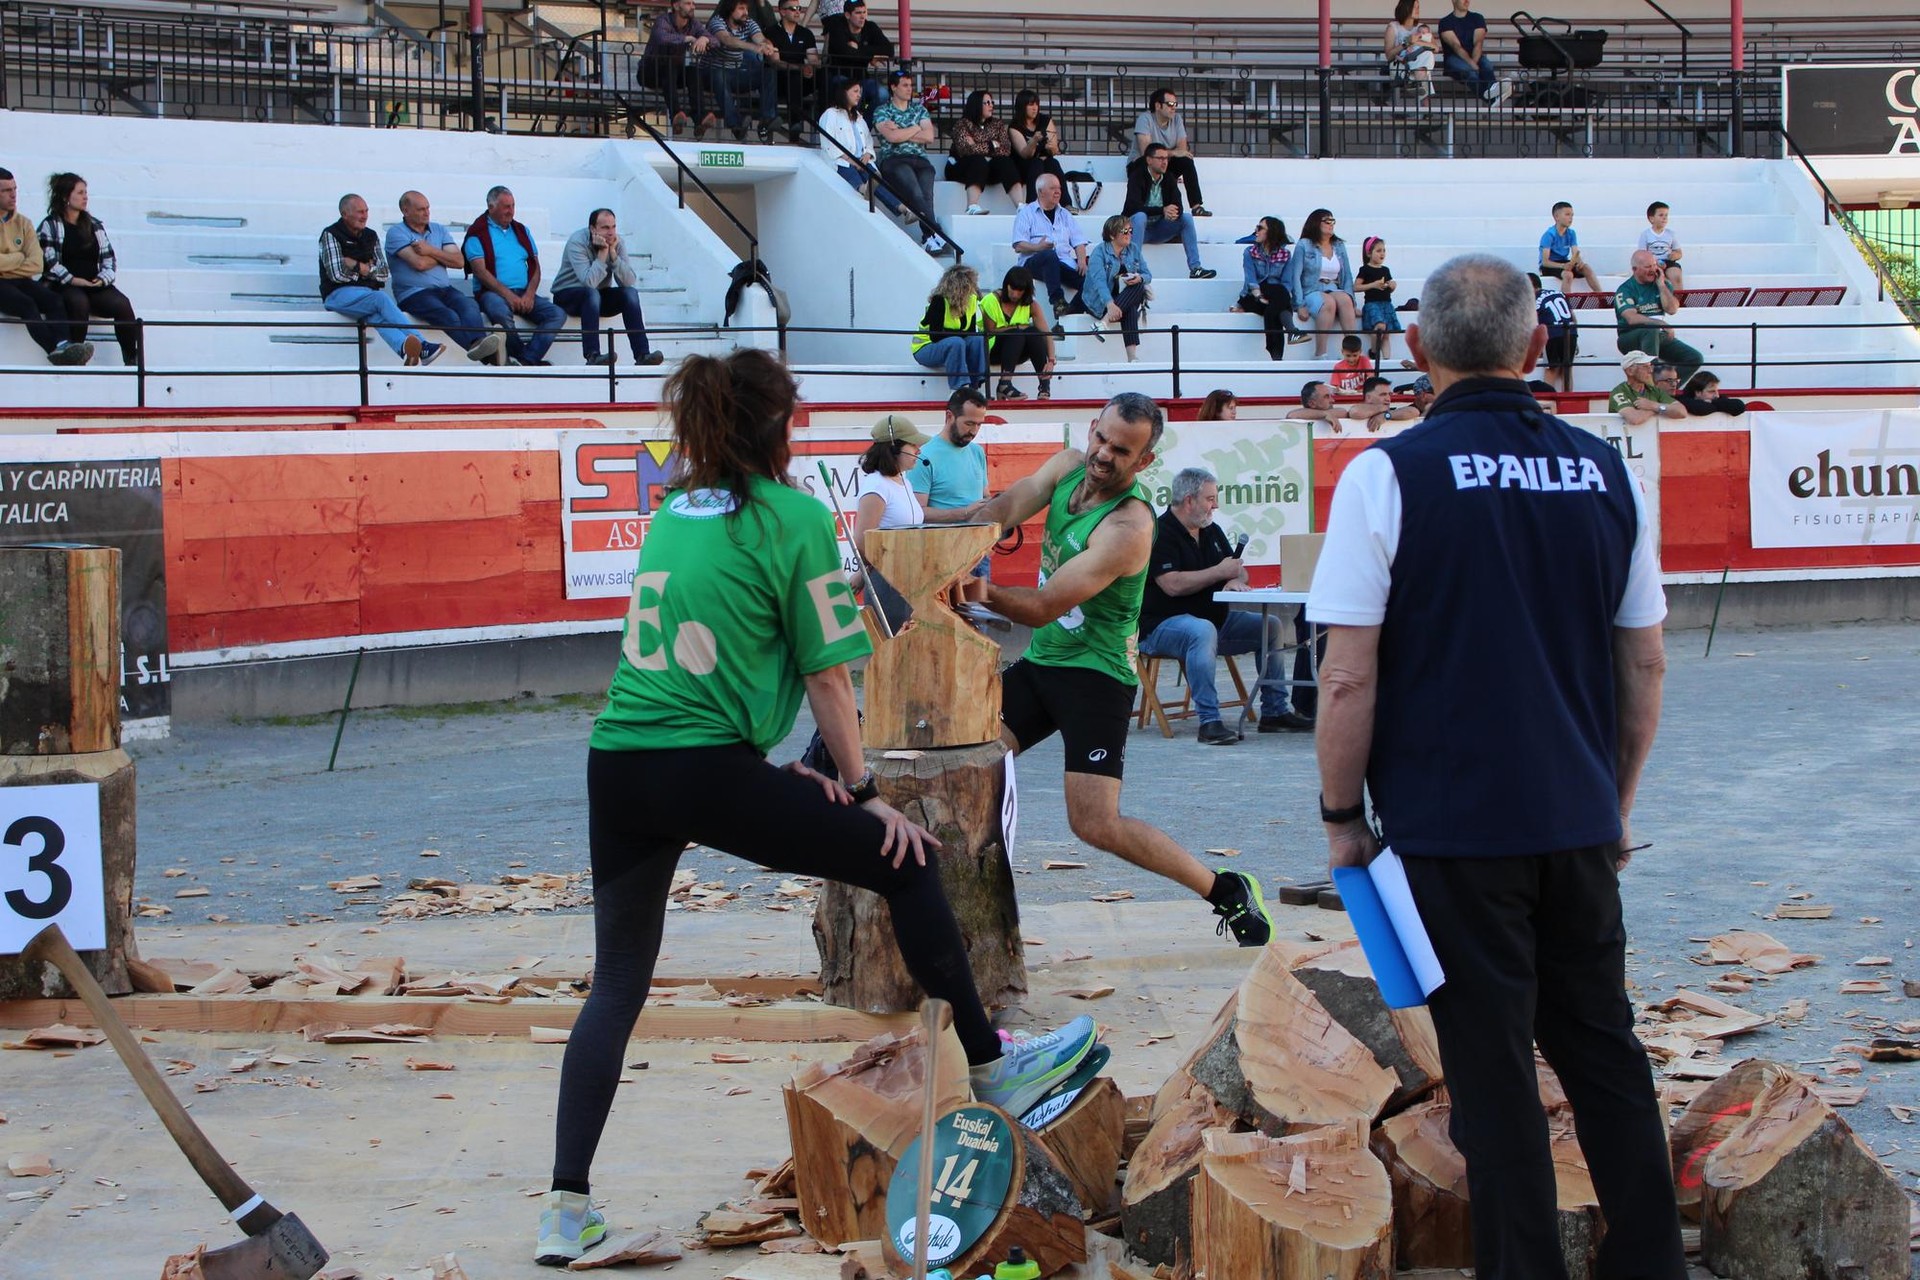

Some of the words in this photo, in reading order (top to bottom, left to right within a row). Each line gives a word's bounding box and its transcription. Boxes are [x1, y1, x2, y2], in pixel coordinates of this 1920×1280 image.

[701, 153, 743, 165] IRTEERA
[1545, 297, 1571, 322] 10
[10, 470, 24, 491] Y
[28, 467, 162, 491] CARPINTERIA
[1448, 453, 1607, 492] EPAILEA
[1788, 448, 1920, 498] ehun
[1793, 512, 1920, 525] FISIOTERAPIA
[3, 815, 72, 920] 3
[930, 1153, 980, 1209] 14
